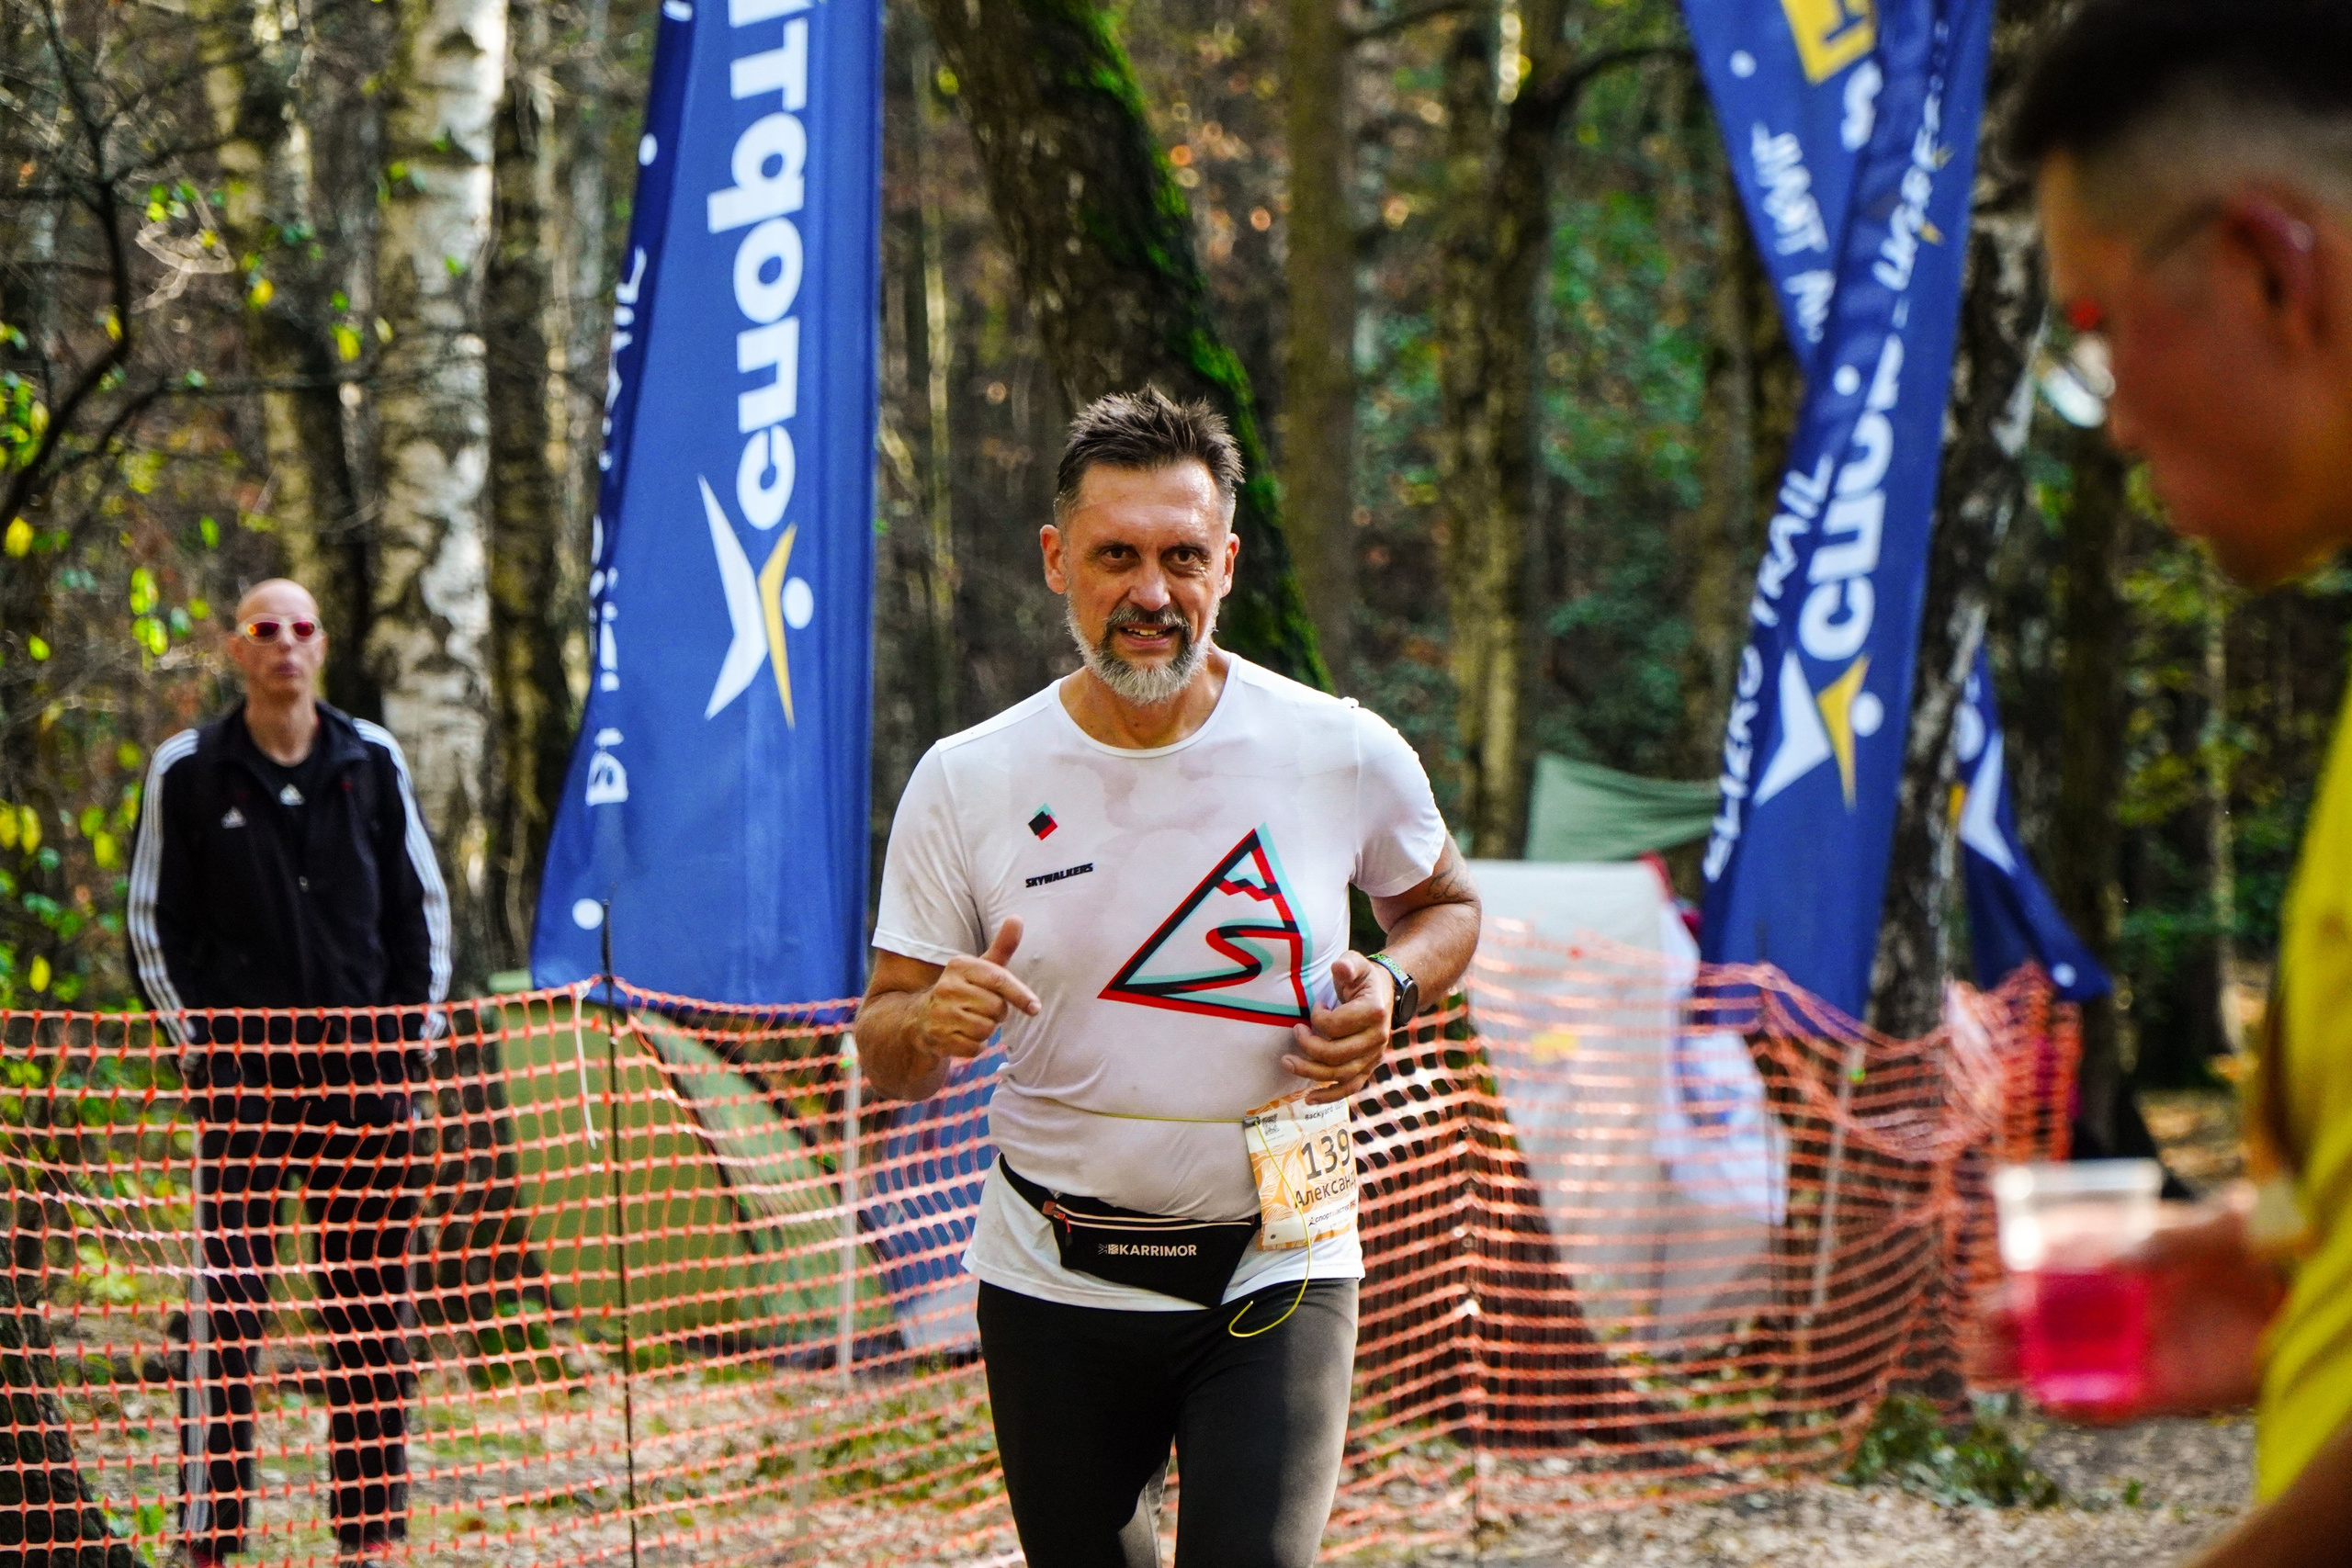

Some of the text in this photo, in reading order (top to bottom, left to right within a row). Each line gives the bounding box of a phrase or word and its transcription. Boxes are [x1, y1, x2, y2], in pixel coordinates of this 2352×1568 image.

[1025, 863, 1093, 888] SKYWALKERS
[1301, 1128, 1351, 1180] 139
[1119, 1244, 1197, 1257] KARRIMOR
